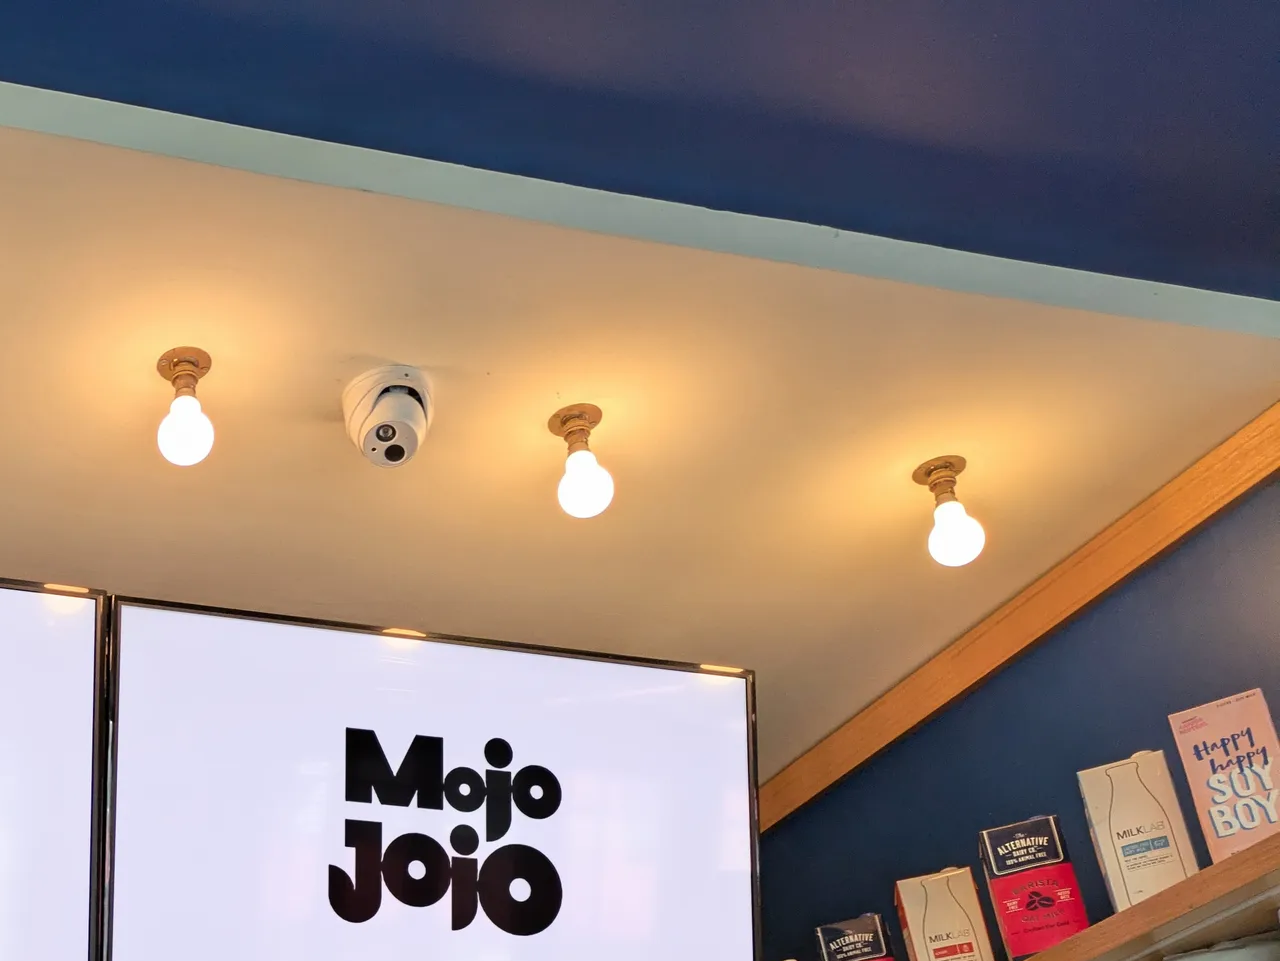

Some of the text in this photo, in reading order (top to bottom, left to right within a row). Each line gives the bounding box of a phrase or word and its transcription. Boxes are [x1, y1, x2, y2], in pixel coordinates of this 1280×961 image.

[1193, 727, 1255, 761] Happy
[1209, 746, 1269, 775] happy
[345, 727, 562, 842] Mojo
[1206, 756, 1273, 804] SOY
[1208, 789, 1280, 838] BOY
[997, 836, 1049, 856] ALTERNATIVE
[1012, 849, 1028, 858] DAIRY
[328, 818, 563, 936] Jojo
[1013, 878, 1059, 896] BARISTA
[829, 933, 874, 951] ALTERNATIVE
